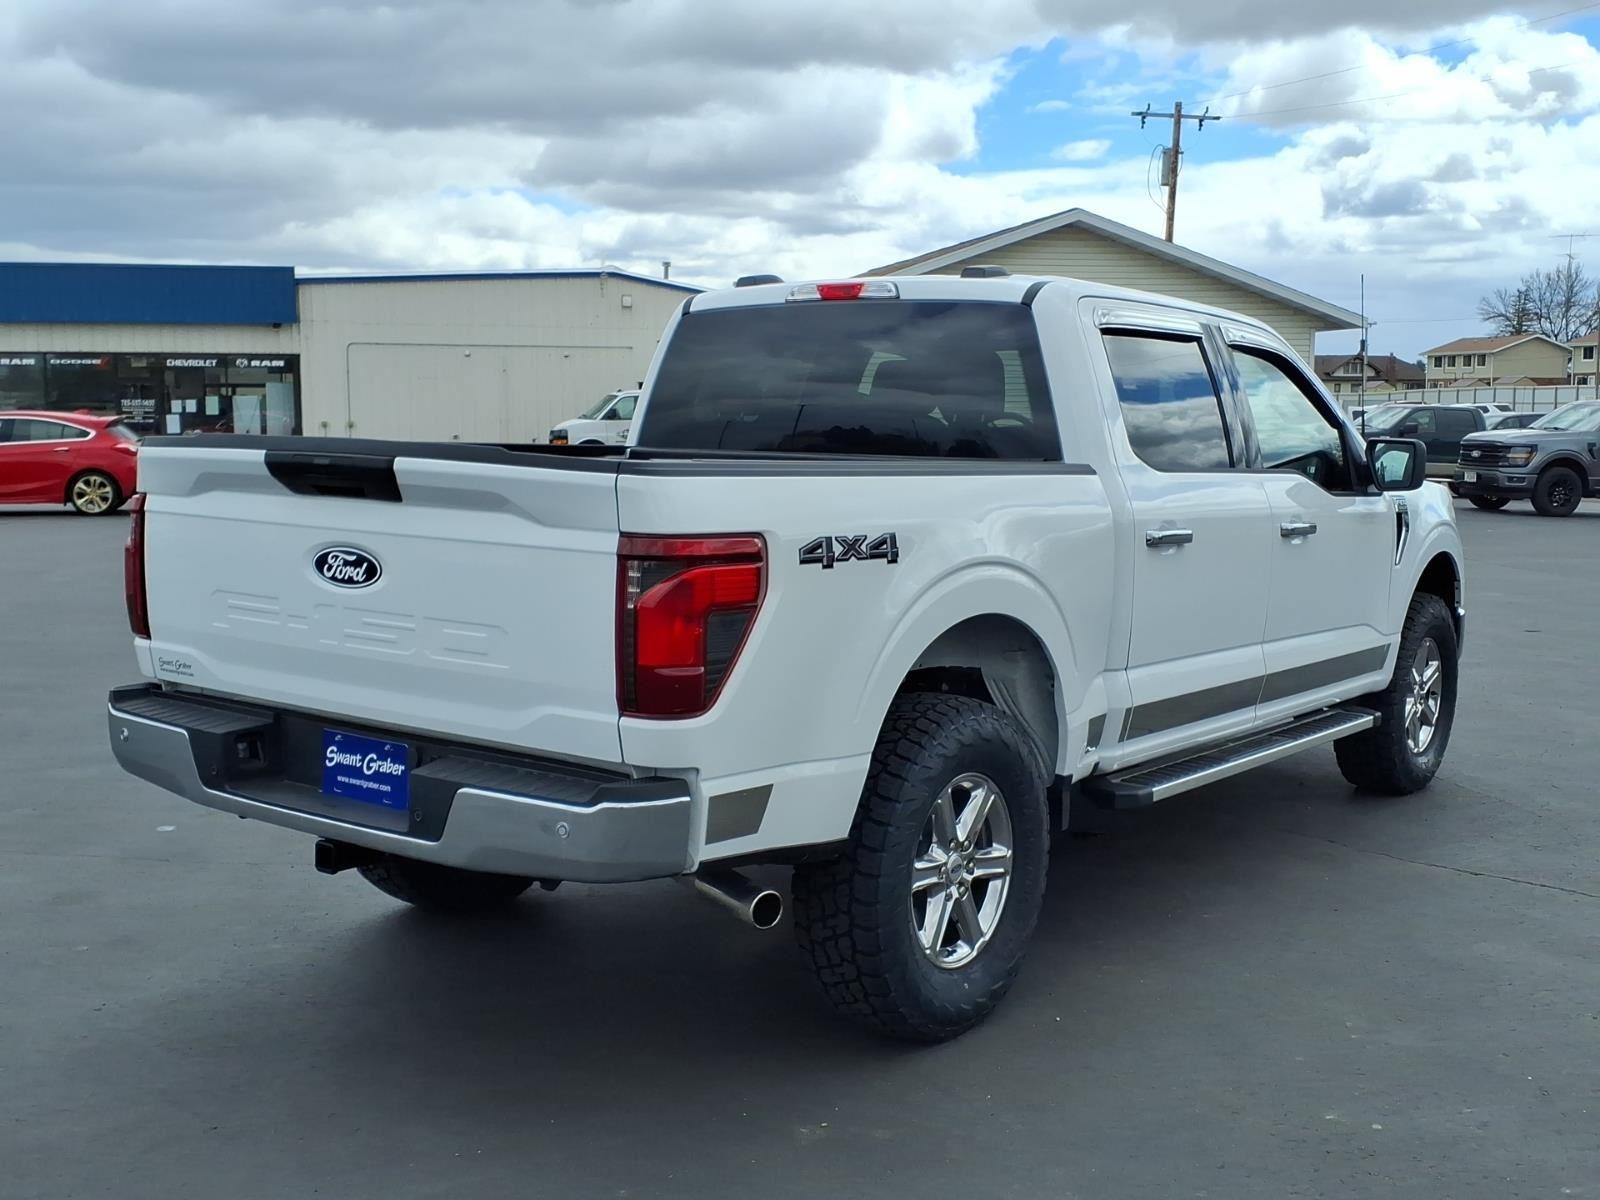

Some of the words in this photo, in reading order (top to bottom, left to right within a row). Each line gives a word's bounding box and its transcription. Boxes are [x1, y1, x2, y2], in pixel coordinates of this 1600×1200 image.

[166, 358, 218, 368] CHEVROLET
[250, 359, 285, 368] RAM
[323, 551, 368, 582] Ford
[325, 745, 362, 768] Swant
[363, 753, 405, 776] Graber
[336, 775, 391, 792] www.swantgraber.com
